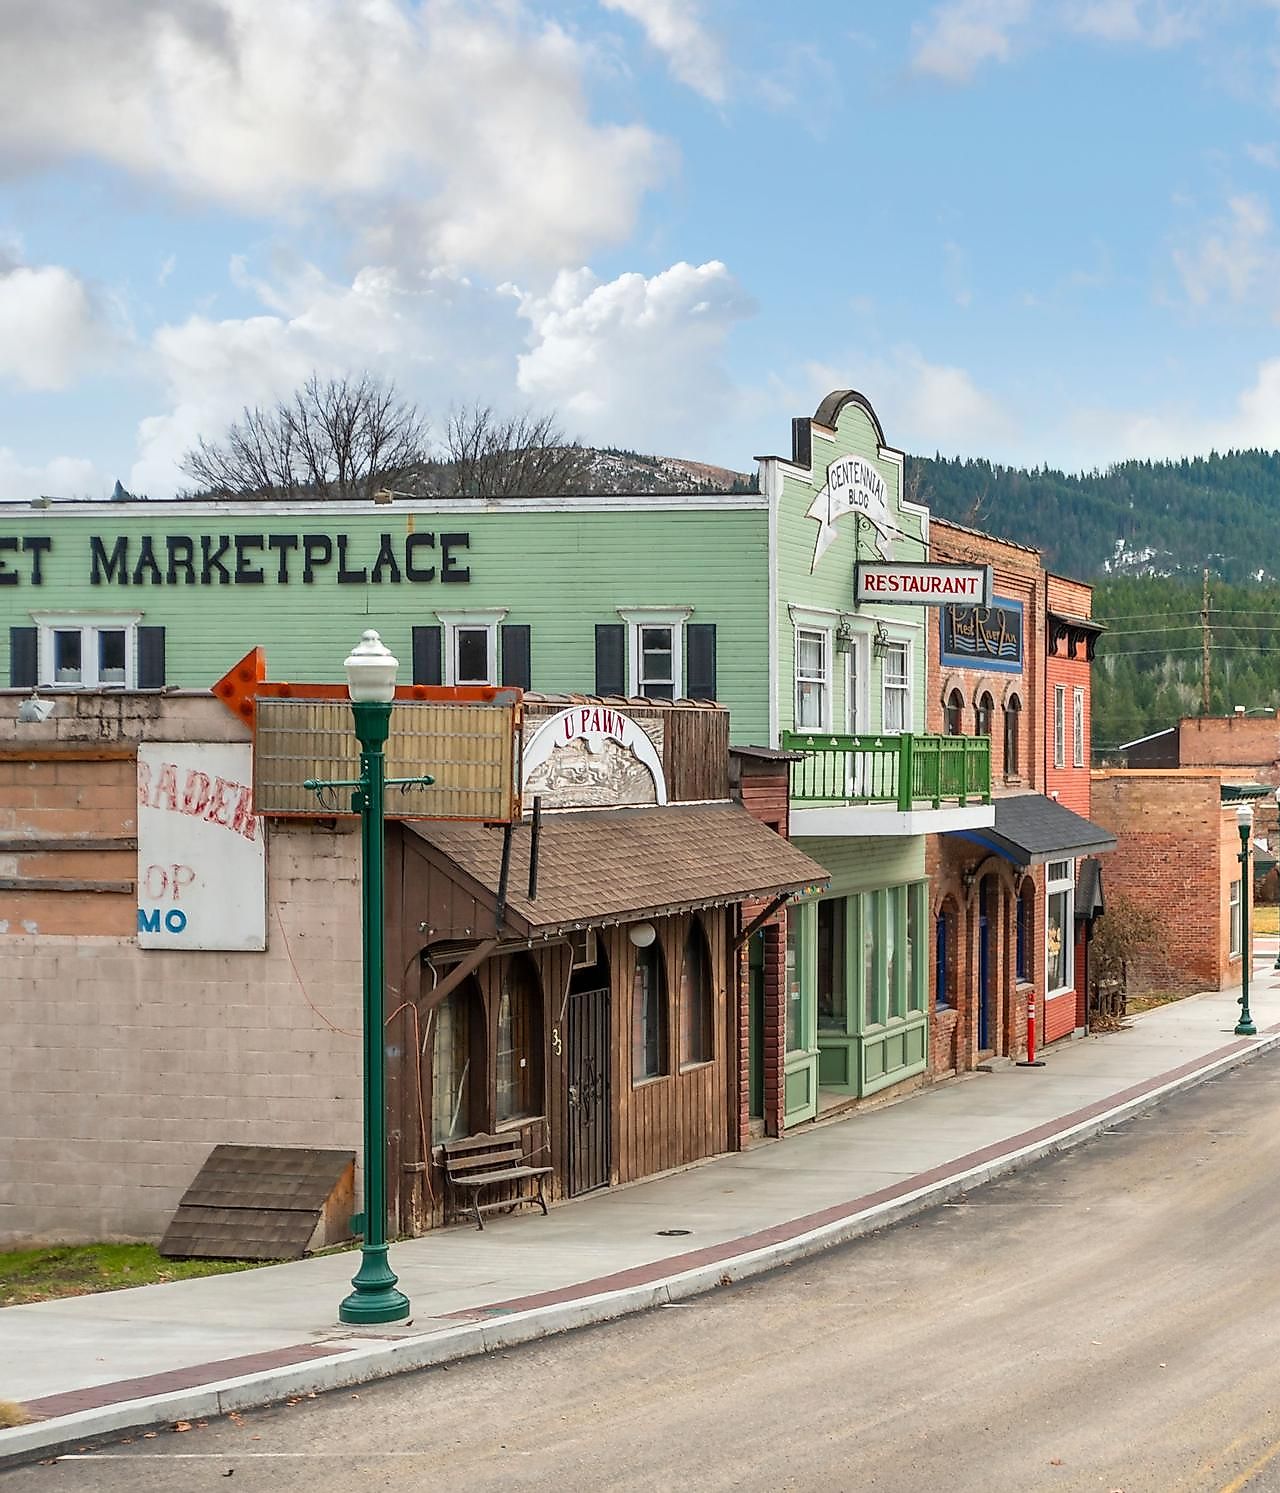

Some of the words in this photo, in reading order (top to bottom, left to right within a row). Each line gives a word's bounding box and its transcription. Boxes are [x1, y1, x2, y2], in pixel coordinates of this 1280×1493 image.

[830, 461, 885, 508] CENTENNIAL
[0, 536, 51, 585] ET
[90, 533, 470, 585] MARKETPLACE
[864, 574, 979, 595] RESTAURANT
[564, 714, 575, 740] U
[581, 708, 626, 741] PAWN
[144, 863, 197, 900] OP
[137, 909, 187, 934] MO
